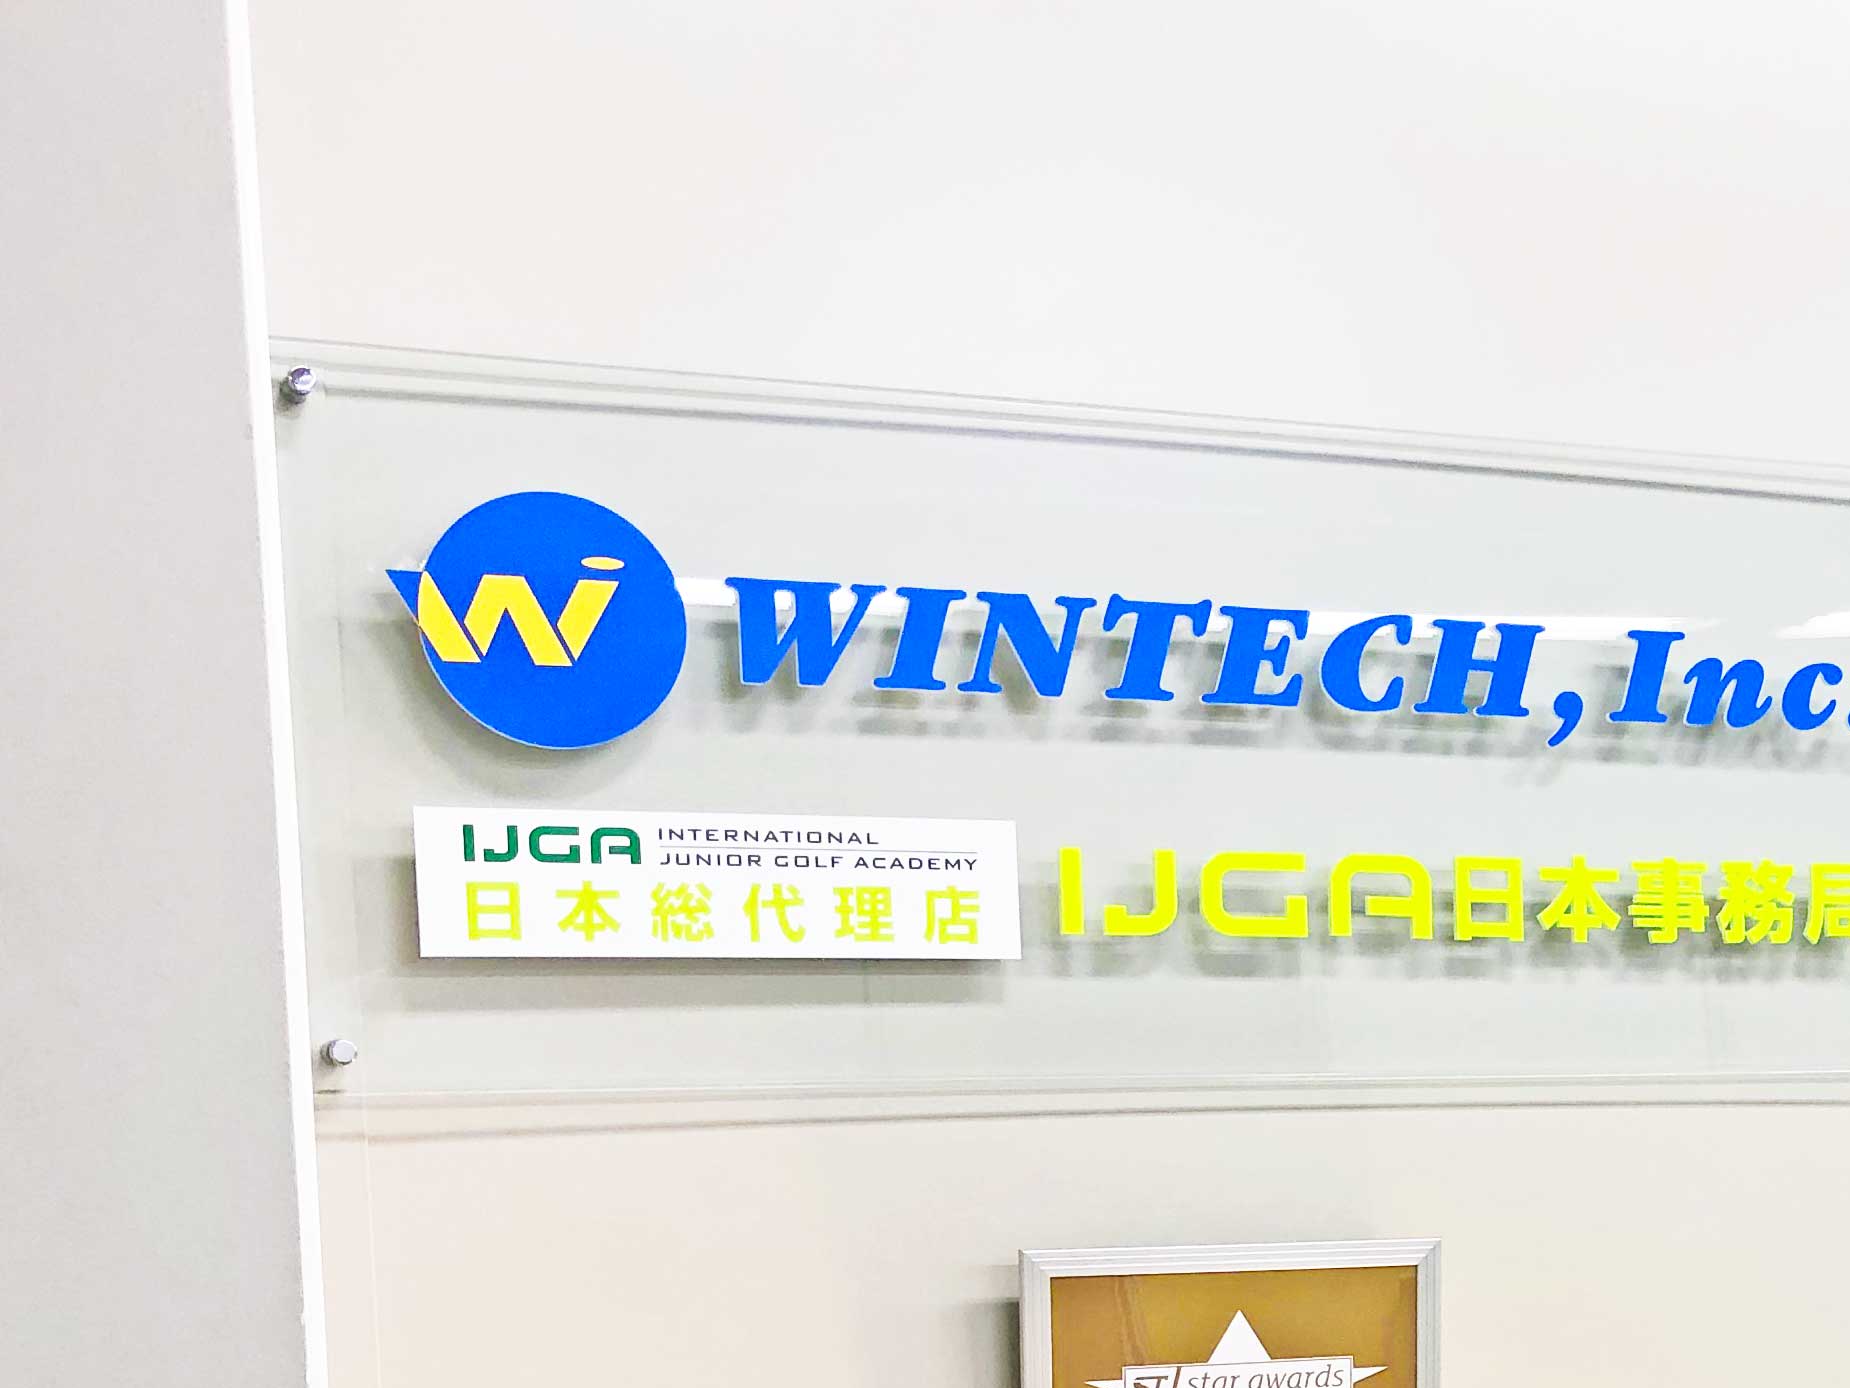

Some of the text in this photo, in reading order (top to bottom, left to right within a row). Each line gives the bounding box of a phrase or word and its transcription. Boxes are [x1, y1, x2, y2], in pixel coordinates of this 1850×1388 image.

[463, 824, 642, 865] IJGA
[658, 827, 880, 845] INTERNATIONAL
[660, 852, 978, 871] JUNIOR GOLF ACADEMY
[465, 880, 980, 944] 日本総代理店
